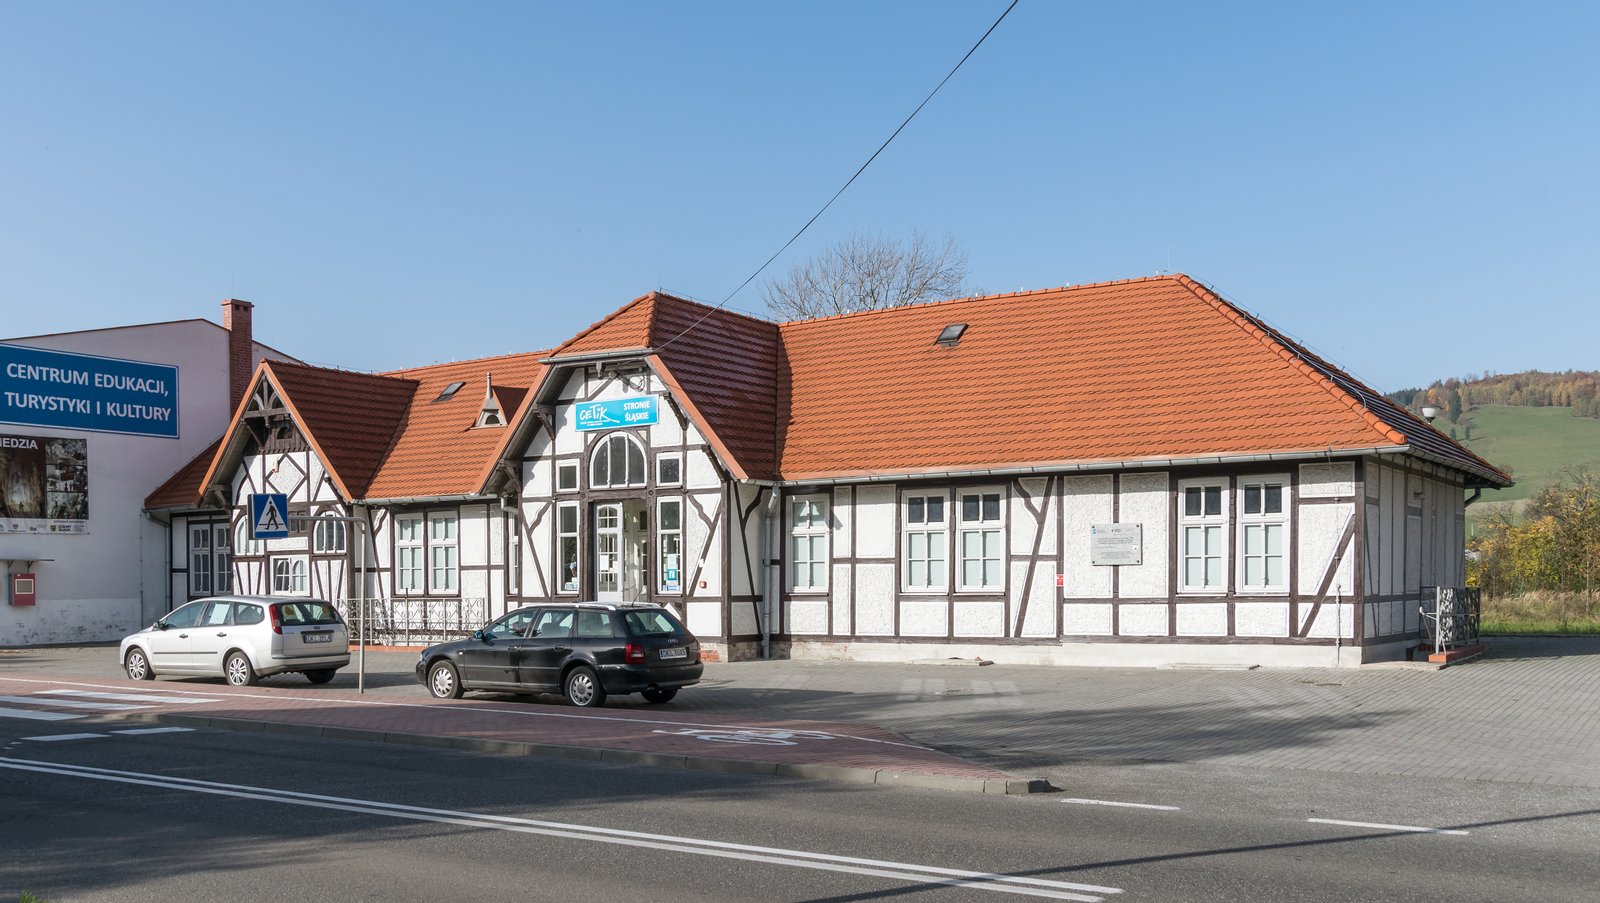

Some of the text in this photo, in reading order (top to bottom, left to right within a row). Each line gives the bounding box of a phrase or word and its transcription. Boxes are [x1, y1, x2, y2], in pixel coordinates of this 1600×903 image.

[6, 362, 169, 397] CENTRUM EDUKACJI,
[4, 391, 171, 422] TURYSTYKI I KULTURY
[623, 401, 650, 411] STRONIE
[624, 412, 649, 422] ŚLĄSKIE
